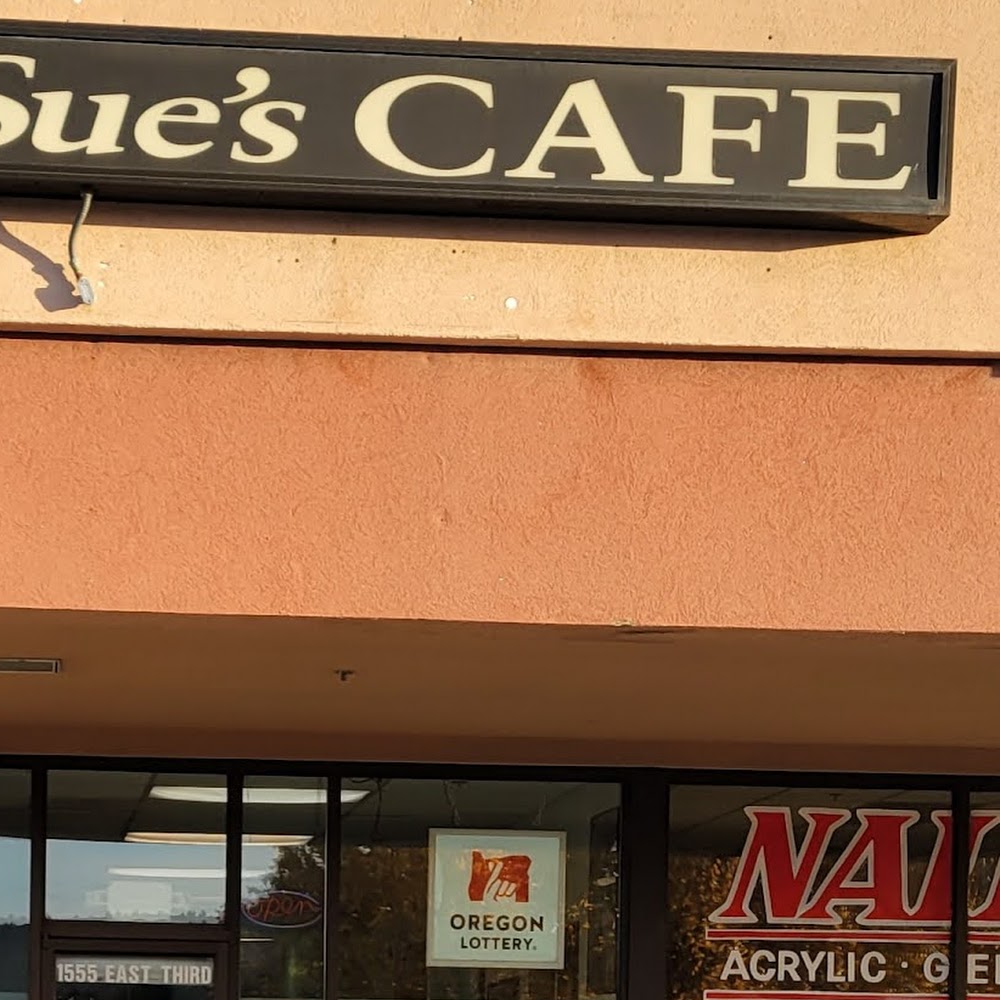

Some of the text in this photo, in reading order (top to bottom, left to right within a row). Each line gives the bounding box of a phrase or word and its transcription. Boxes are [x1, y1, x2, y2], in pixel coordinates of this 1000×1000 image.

[354, 74, 913, 190] CAFE
[450, 914, 544, 932] OREGON
[57, 963, 212, 985] 1555 EAST THIRD
[720, 949, 887, 983] ACRYLIC
